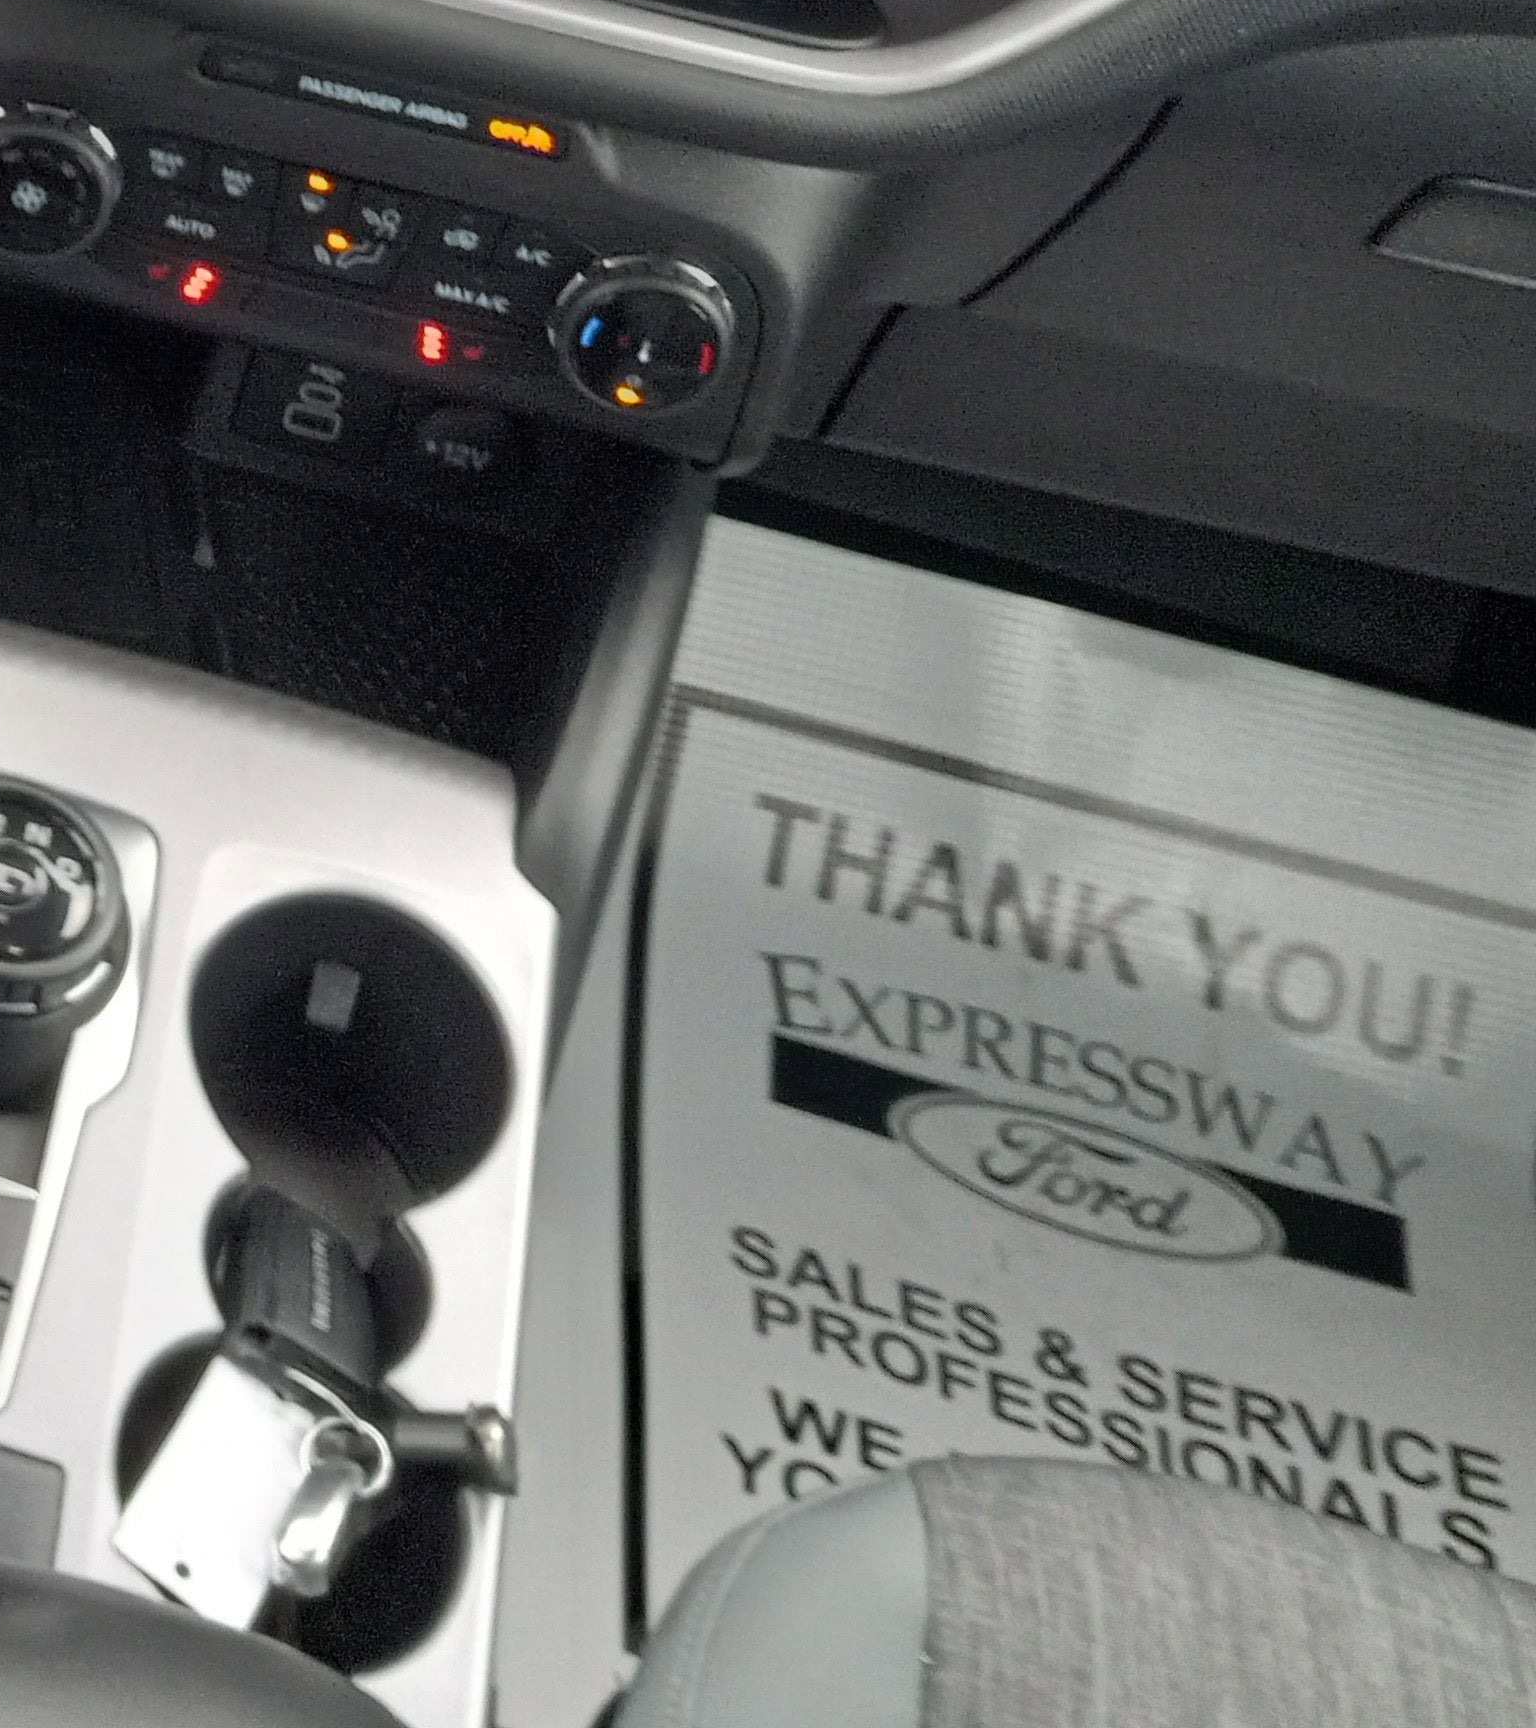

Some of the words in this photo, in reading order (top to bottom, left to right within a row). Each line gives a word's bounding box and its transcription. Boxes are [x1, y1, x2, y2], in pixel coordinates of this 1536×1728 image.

[299, 74, 403, 113] PASSENGER
[404, 101, 469, 130] AIRBAG
[166, 213, 217, 240] AUTO
[434, 279, 475, 304] MAX
[753, 791, 1154, 990] THANK
[1187, 908, 1476, 1077] YOU!
[759, 950, 1426, 1205] EXPRESSWAY
[976, 1117, 1190, 1238] Ford
[729, 1225, 1005, 1357] SALES
[1034, 1325, 1090, 1388] &
[1117, 1353, 1512, 1512] SERVICE
[751, 1285, 1499, 1571] PROFESSIONALS
[769, 1384, 904, 1472] WE
